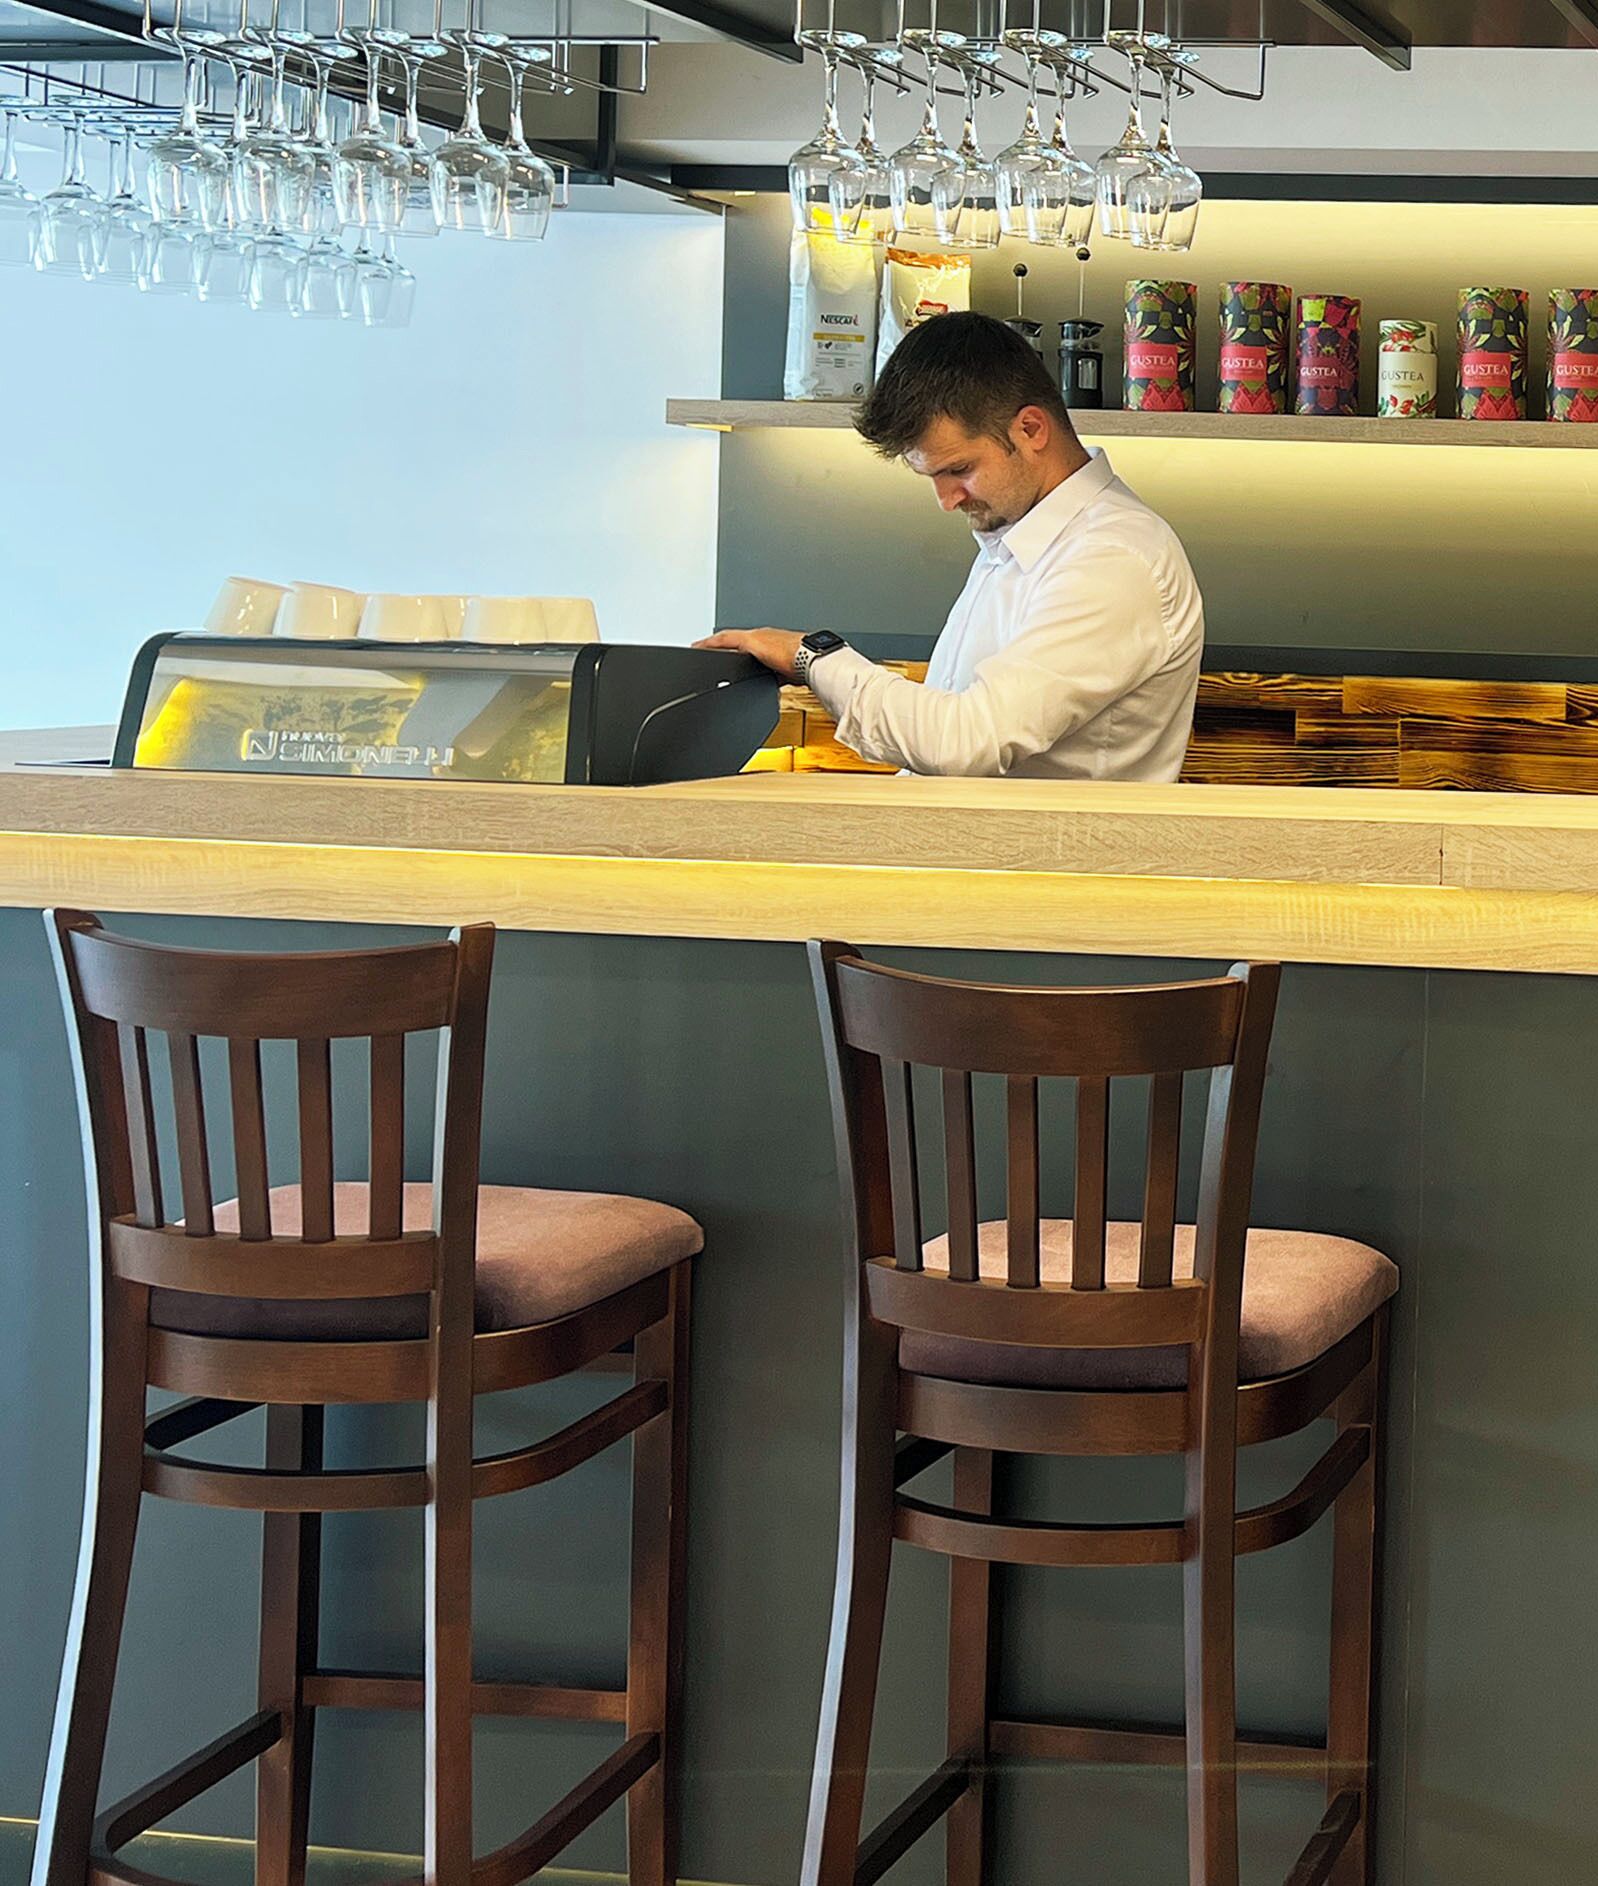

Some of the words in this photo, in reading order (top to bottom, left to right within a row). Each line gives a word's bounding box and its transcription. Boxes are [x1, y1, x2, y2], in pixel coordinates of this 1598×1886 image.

[1130, 355, 1176, 366] GUSTEA
[1221, 357, 1265, 369] GUSTEA
[1300, 366, 1338, 377] GUSTEA
[1463, 363, 1509, 376] GUSTEA
[1381, 370, 1425, 382] GUSTEA
